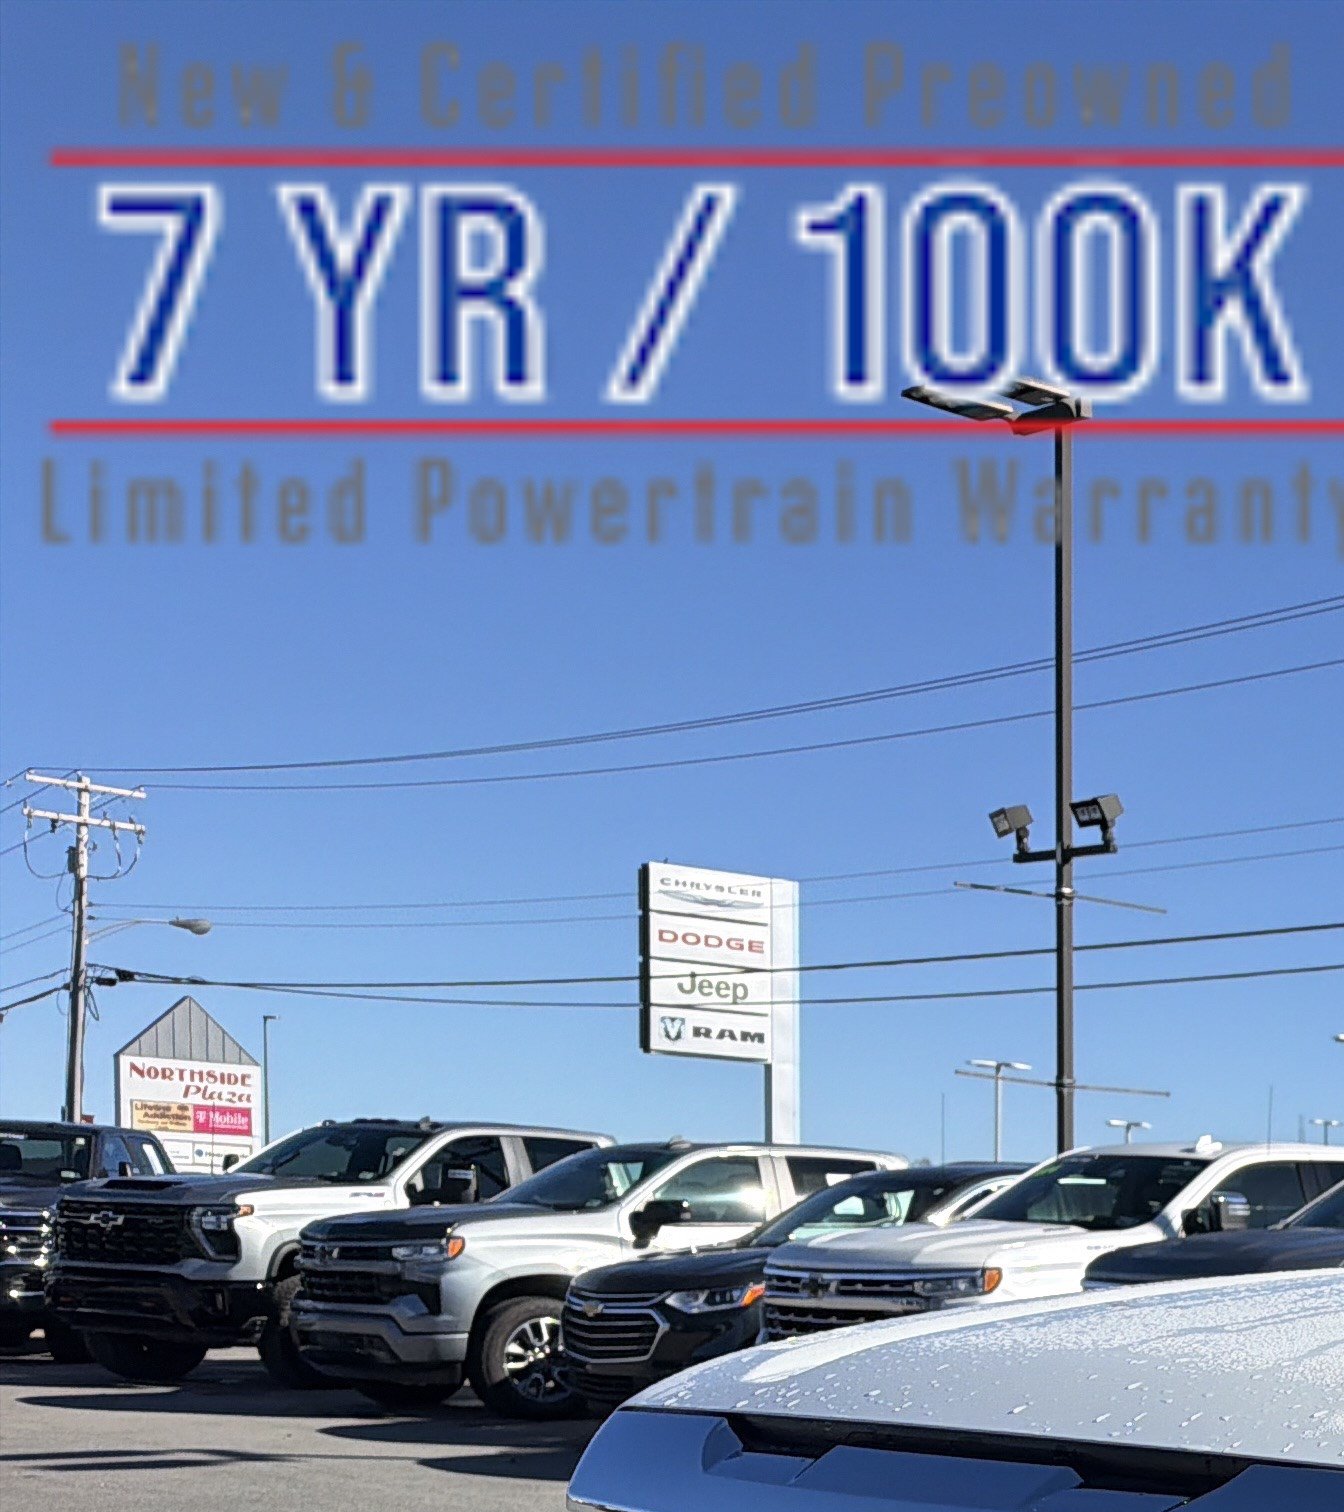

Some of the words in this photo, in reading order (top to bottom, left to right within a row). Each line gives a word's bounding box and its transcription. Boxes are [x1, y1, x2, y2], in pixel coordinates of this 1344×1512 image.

[659, 876, 762, 899] CHRYSLER
[657, 928, 765, 955] DODGE
[676, 972, 749, 1005] Jeep
[692, 1025, 766, 1045] RAM
[129, 1061, 252, 1087] NORTHSIDE
[182, 1084, 252, 1104] Plaza
[208, 1111, 249, 1124] Mobile
